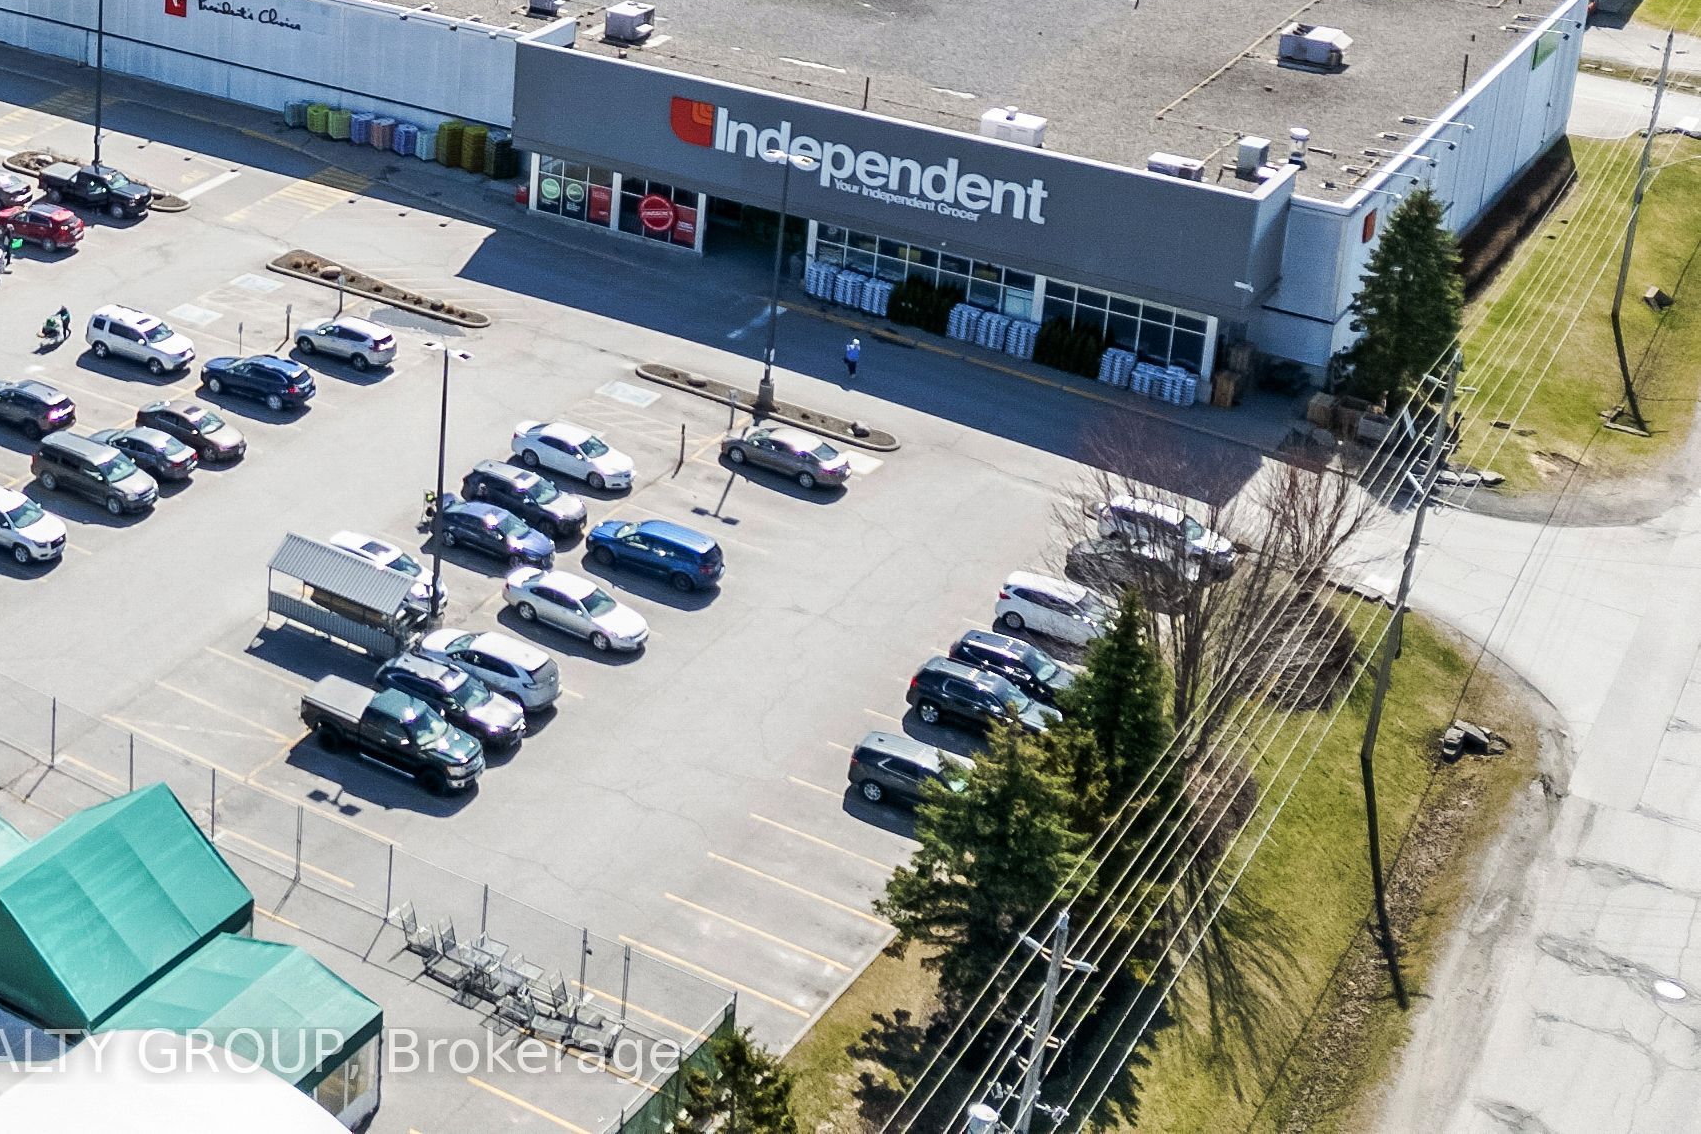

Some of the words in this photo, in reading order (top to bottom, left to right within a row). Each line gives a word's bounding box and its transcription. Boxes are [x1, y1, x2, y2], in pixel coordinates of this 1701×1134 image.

[259, 8, 301, 31] Choice
[715, 106, 1049, 225] Independent
[834, 178, 860, 194] Your
[862, 185, 936, 211] Independent
[937, 202, 980, 222] Grocer
